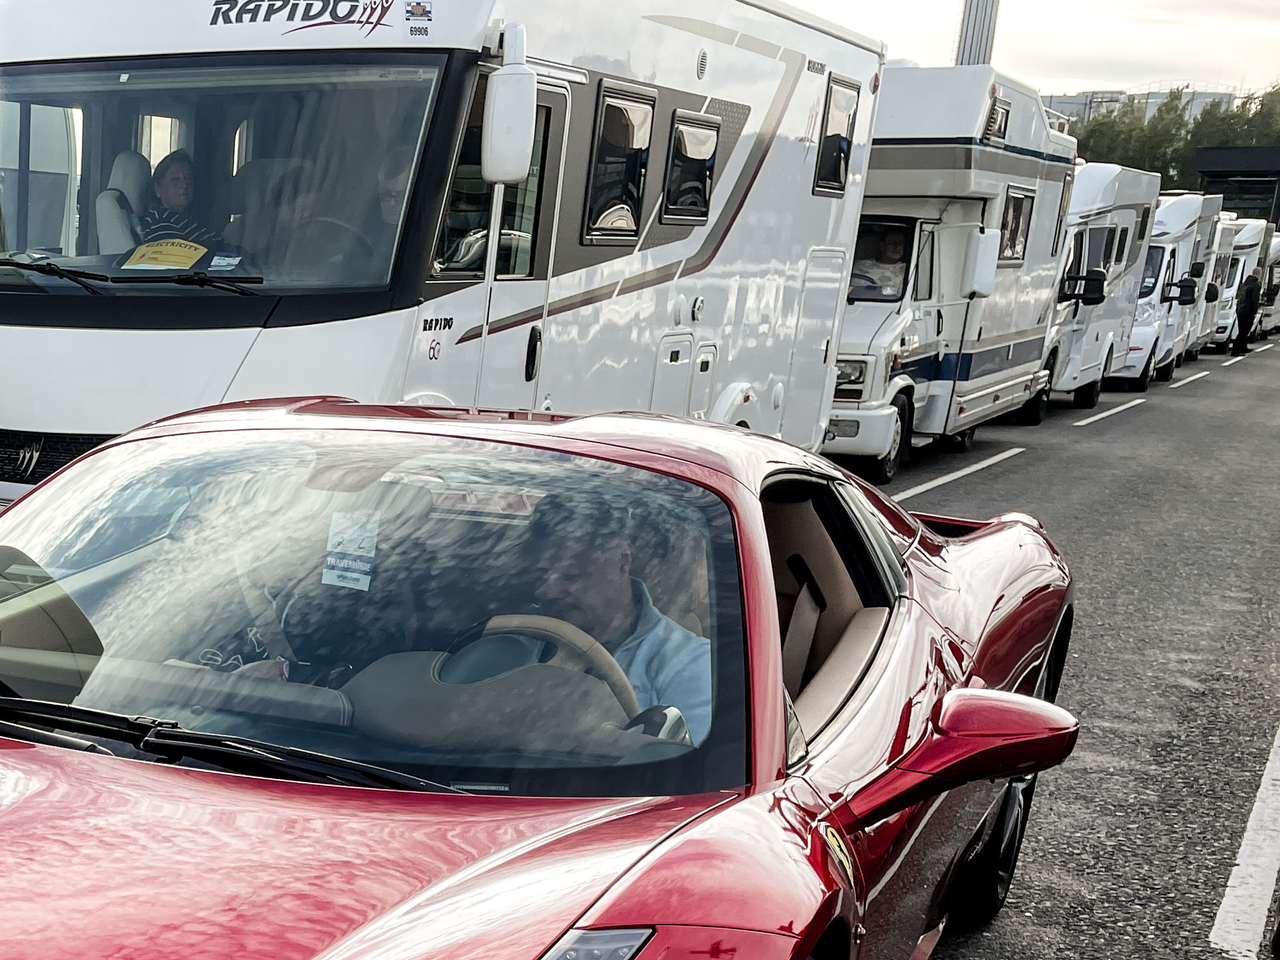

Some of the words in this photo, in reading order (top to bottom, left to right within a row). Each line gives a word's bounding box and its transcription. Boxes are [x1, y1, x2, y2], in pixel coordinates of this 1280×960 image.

[210, 0, 358, 24] RAPIDO
[410, 26, 428, 36] 69906
[146, 241, 200, 251] ELECTRICITY
[423, 317, 454, 331] RAPIDO
